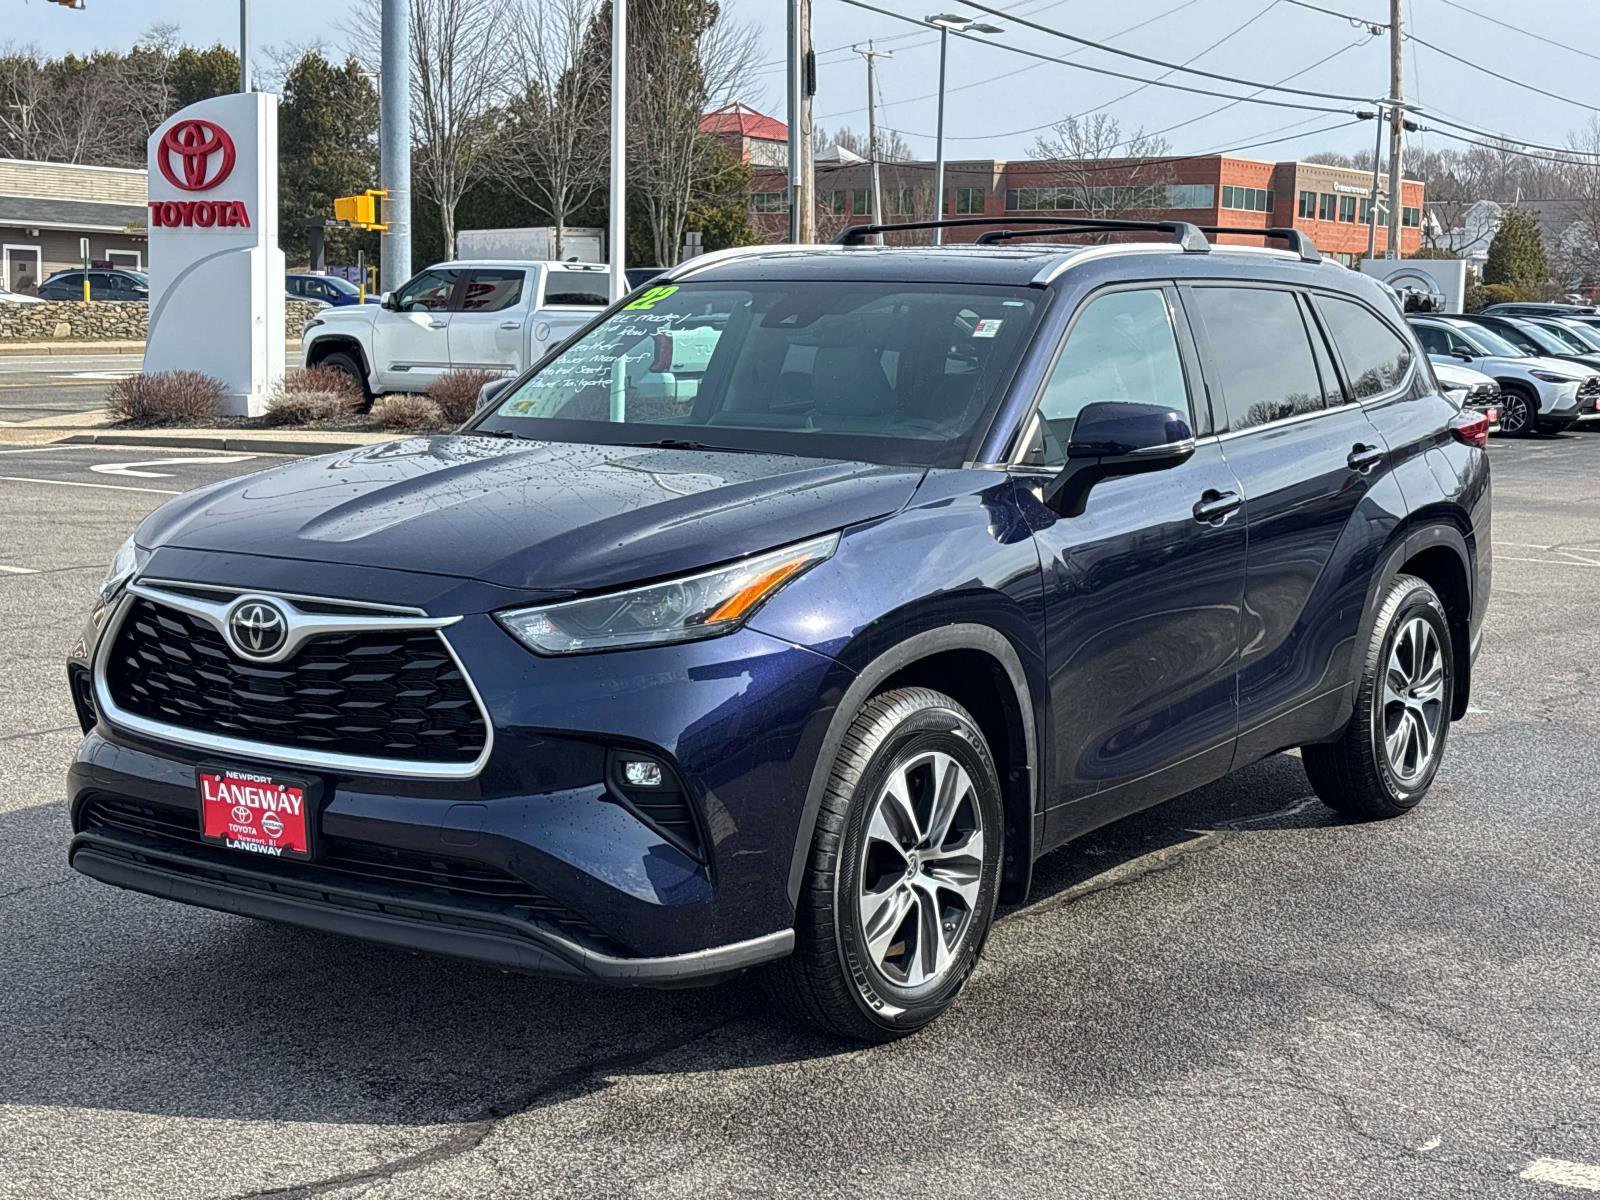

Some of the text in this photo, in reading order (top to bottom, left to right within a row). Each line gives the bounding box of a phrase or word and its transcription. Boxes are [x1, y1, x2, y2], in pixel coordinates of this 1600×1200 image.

[148, 201, 250, 227] TOYOTA
[624, 285, 680, 310] 22
[617, 326, 647, 337] Row
[226, 771, 272, 784] NEWPORT
[203, 780, 302, 816] LANGWAY
[229, 823, 257, 835] TOYOTA
[226, 838, 282, 856] LANGWAY
